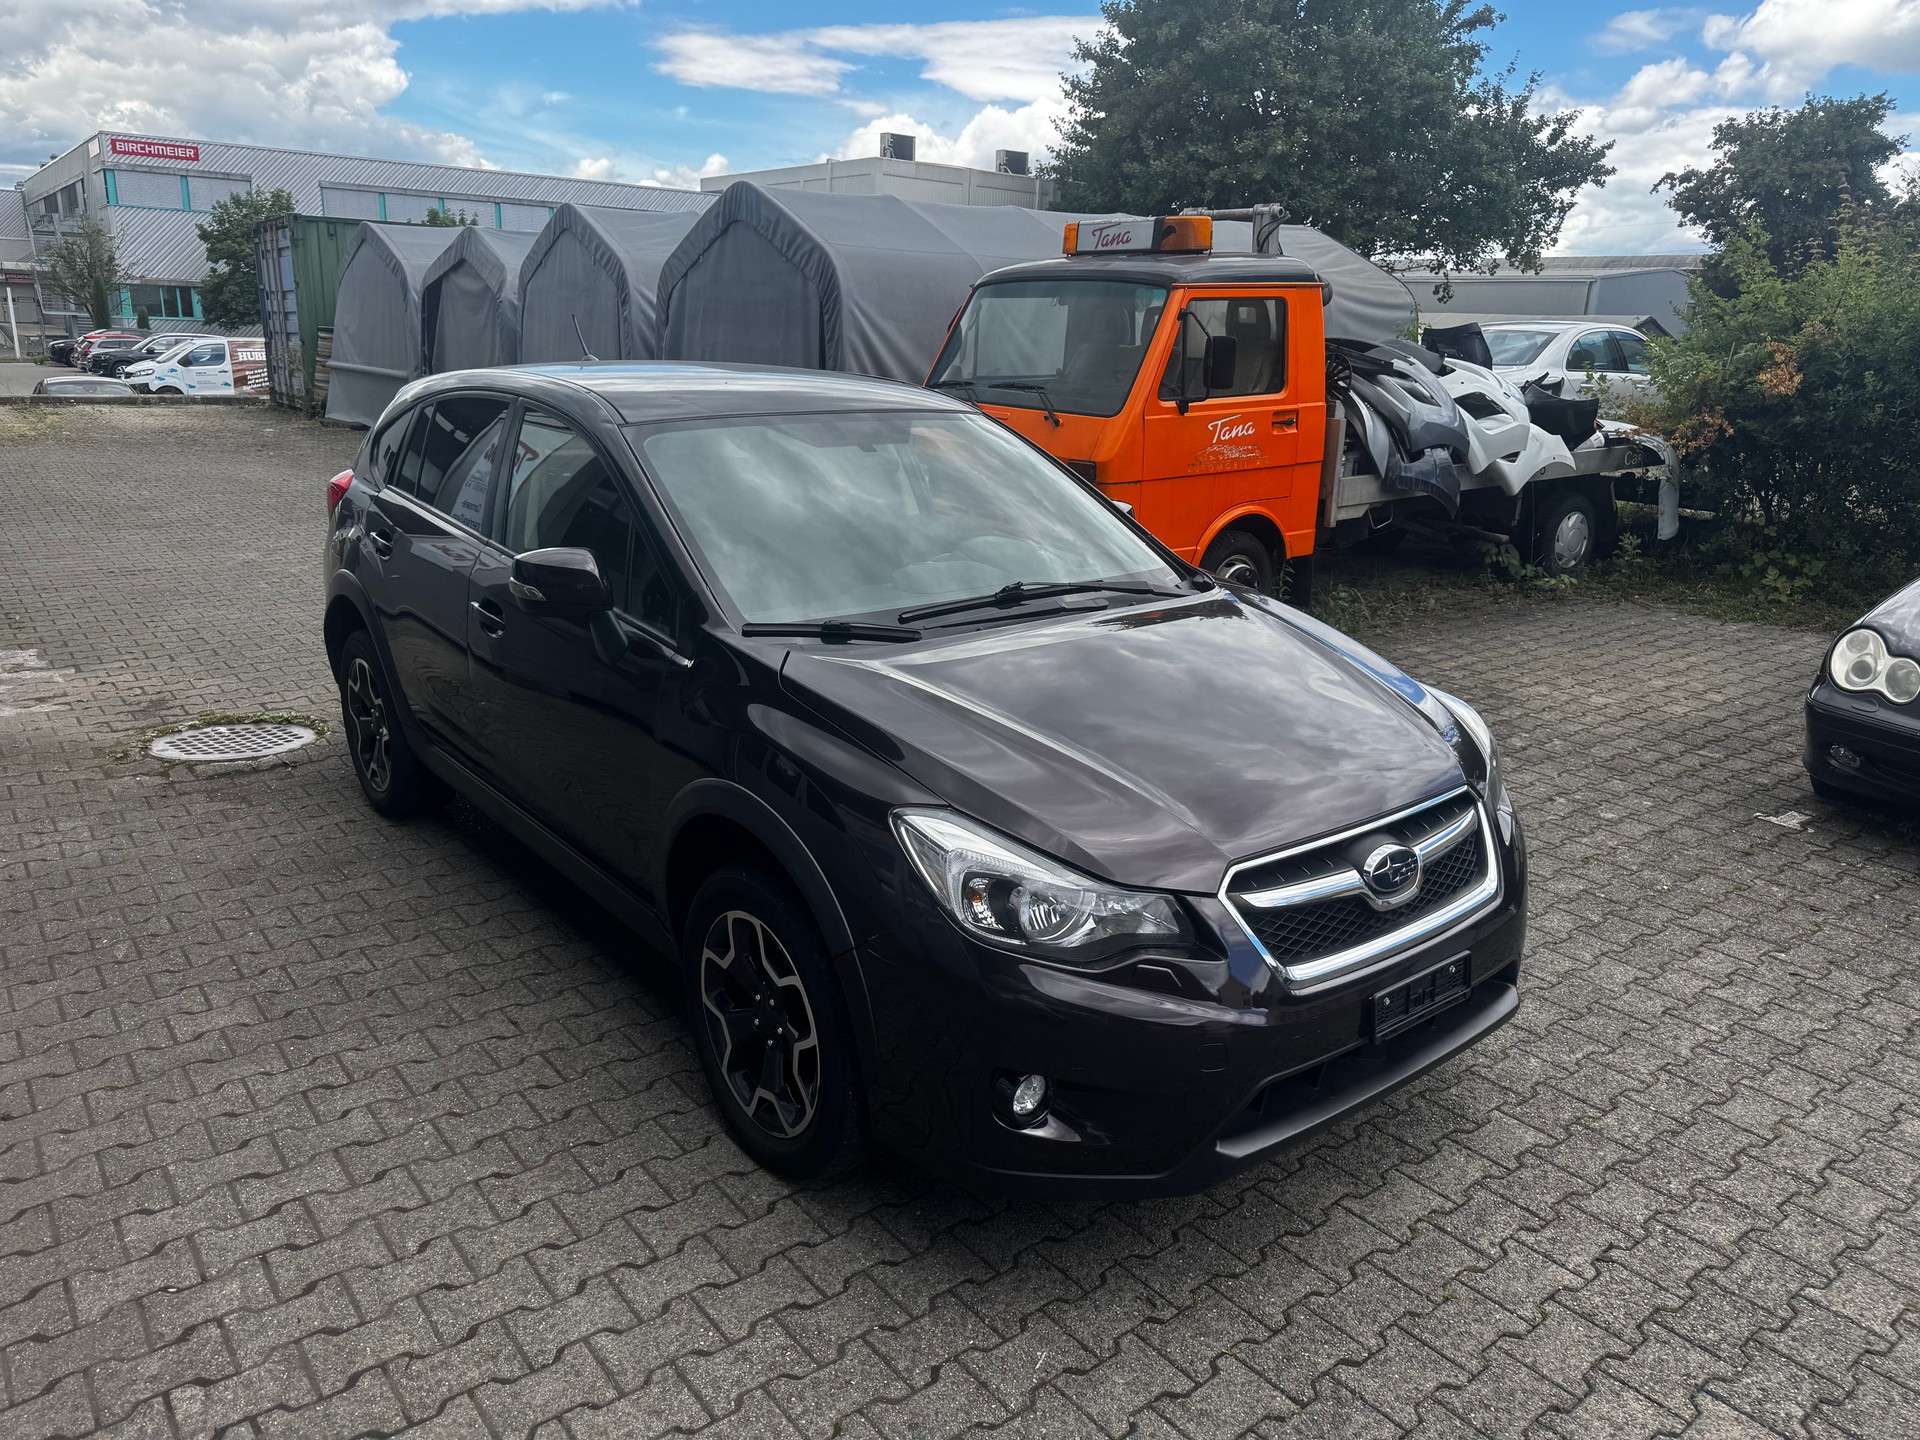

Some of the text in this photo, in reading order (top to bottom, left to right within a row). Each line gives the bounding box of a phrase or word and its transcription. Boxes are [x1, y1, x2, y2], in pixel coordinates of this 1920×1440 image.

[115, 141, 196, 158] BIRCHMEIER
[1092, 222, 1132, 250] Tana
[1208, 414, 1255, 443] Tana
